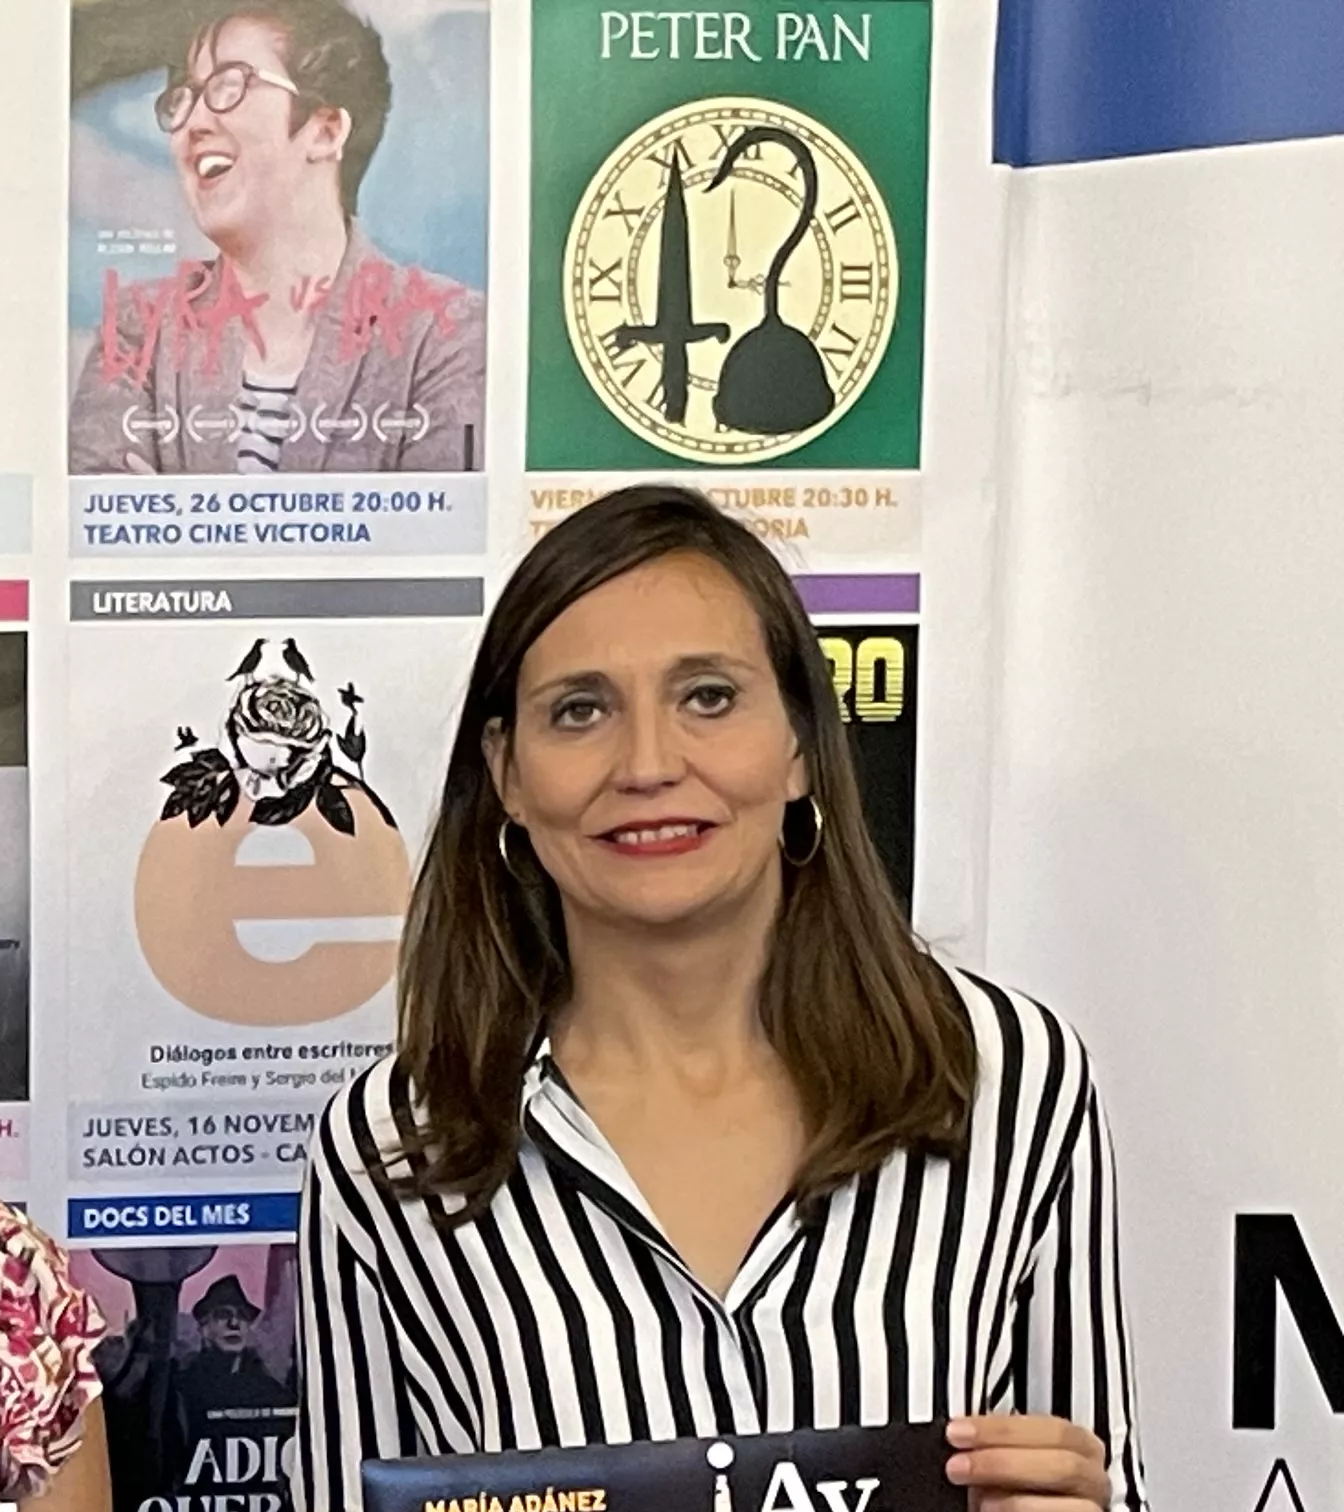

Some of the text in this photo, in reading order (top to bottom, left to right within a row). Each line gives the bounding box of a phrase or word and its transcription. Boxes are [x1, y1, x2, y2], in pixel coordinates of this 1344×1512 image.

[601, 12, 872, 62] PETER PAN
[84, 493, 452, 516] JUEVES, 26 OCTUBRE 20:00 H.
[803, 487, 869, 508] 20:30
[875, 487, 897, 508] H.
[84, 522, 370, 546] TEATRO CINE VICTORIA
[93, 591, 233, 614] LITERATURA
[151, 1044, 236, 1065] Diálogos
[242, 1045, 292, 1060] entre
[320, 1069, 344, 1083] del
[83, 1114, 313, 1138] JUEVES, 16 NOVEM
[83, 1142, 166, 1168] SALÓN
[173, 1145, 255, 1165] ACTOS
[84, 1204, 250, 1229] DOCS DEL MES
